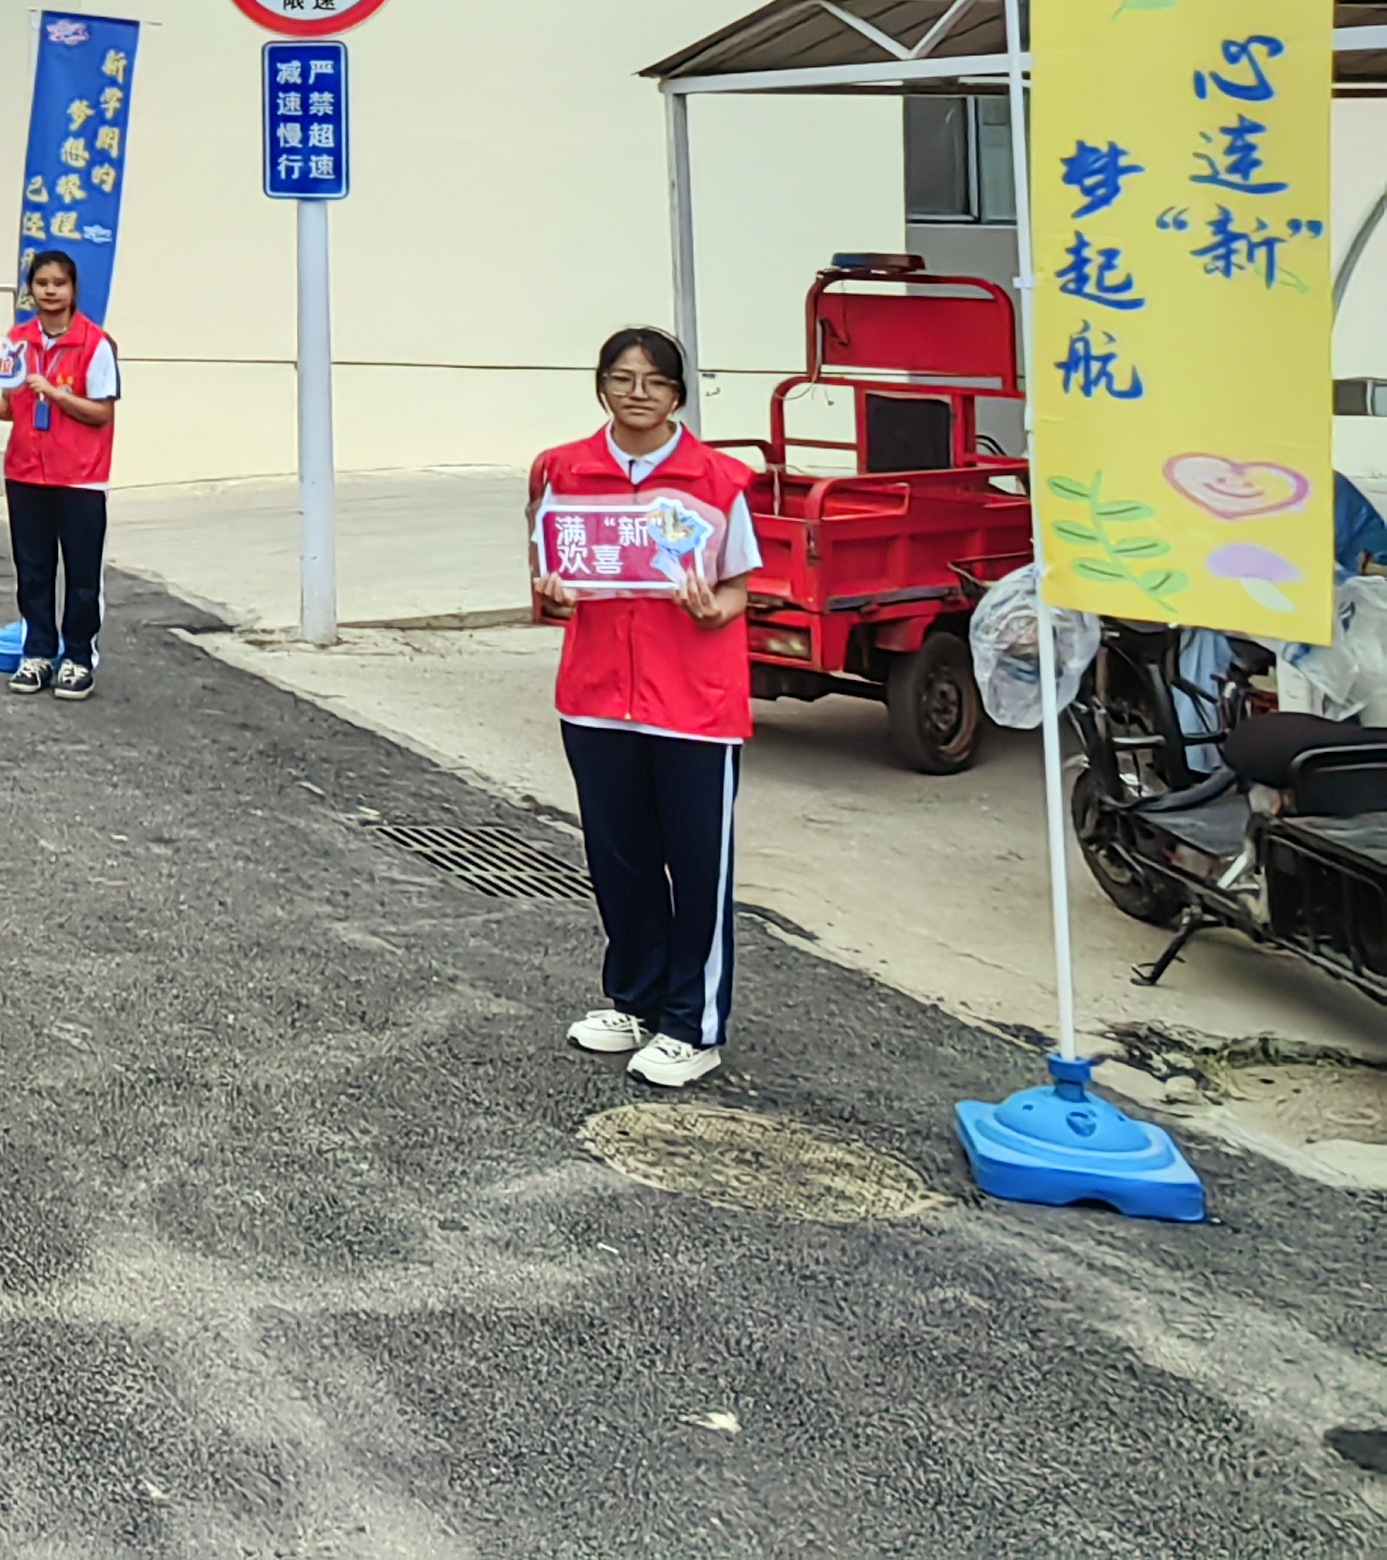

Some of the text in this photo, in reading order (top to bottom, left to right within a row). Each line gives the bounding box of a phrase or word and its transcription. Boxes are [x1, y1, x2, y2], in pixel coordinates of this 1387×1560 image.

[91, 49, 127, 192] 新学期的
[276, 60, 304, 180] 减速慢行
[308, 60, 336, 180] 严禁超速
[1055, 140, 1145, 399] 梦起航
[557, 544, 623, 575] 欢喜
